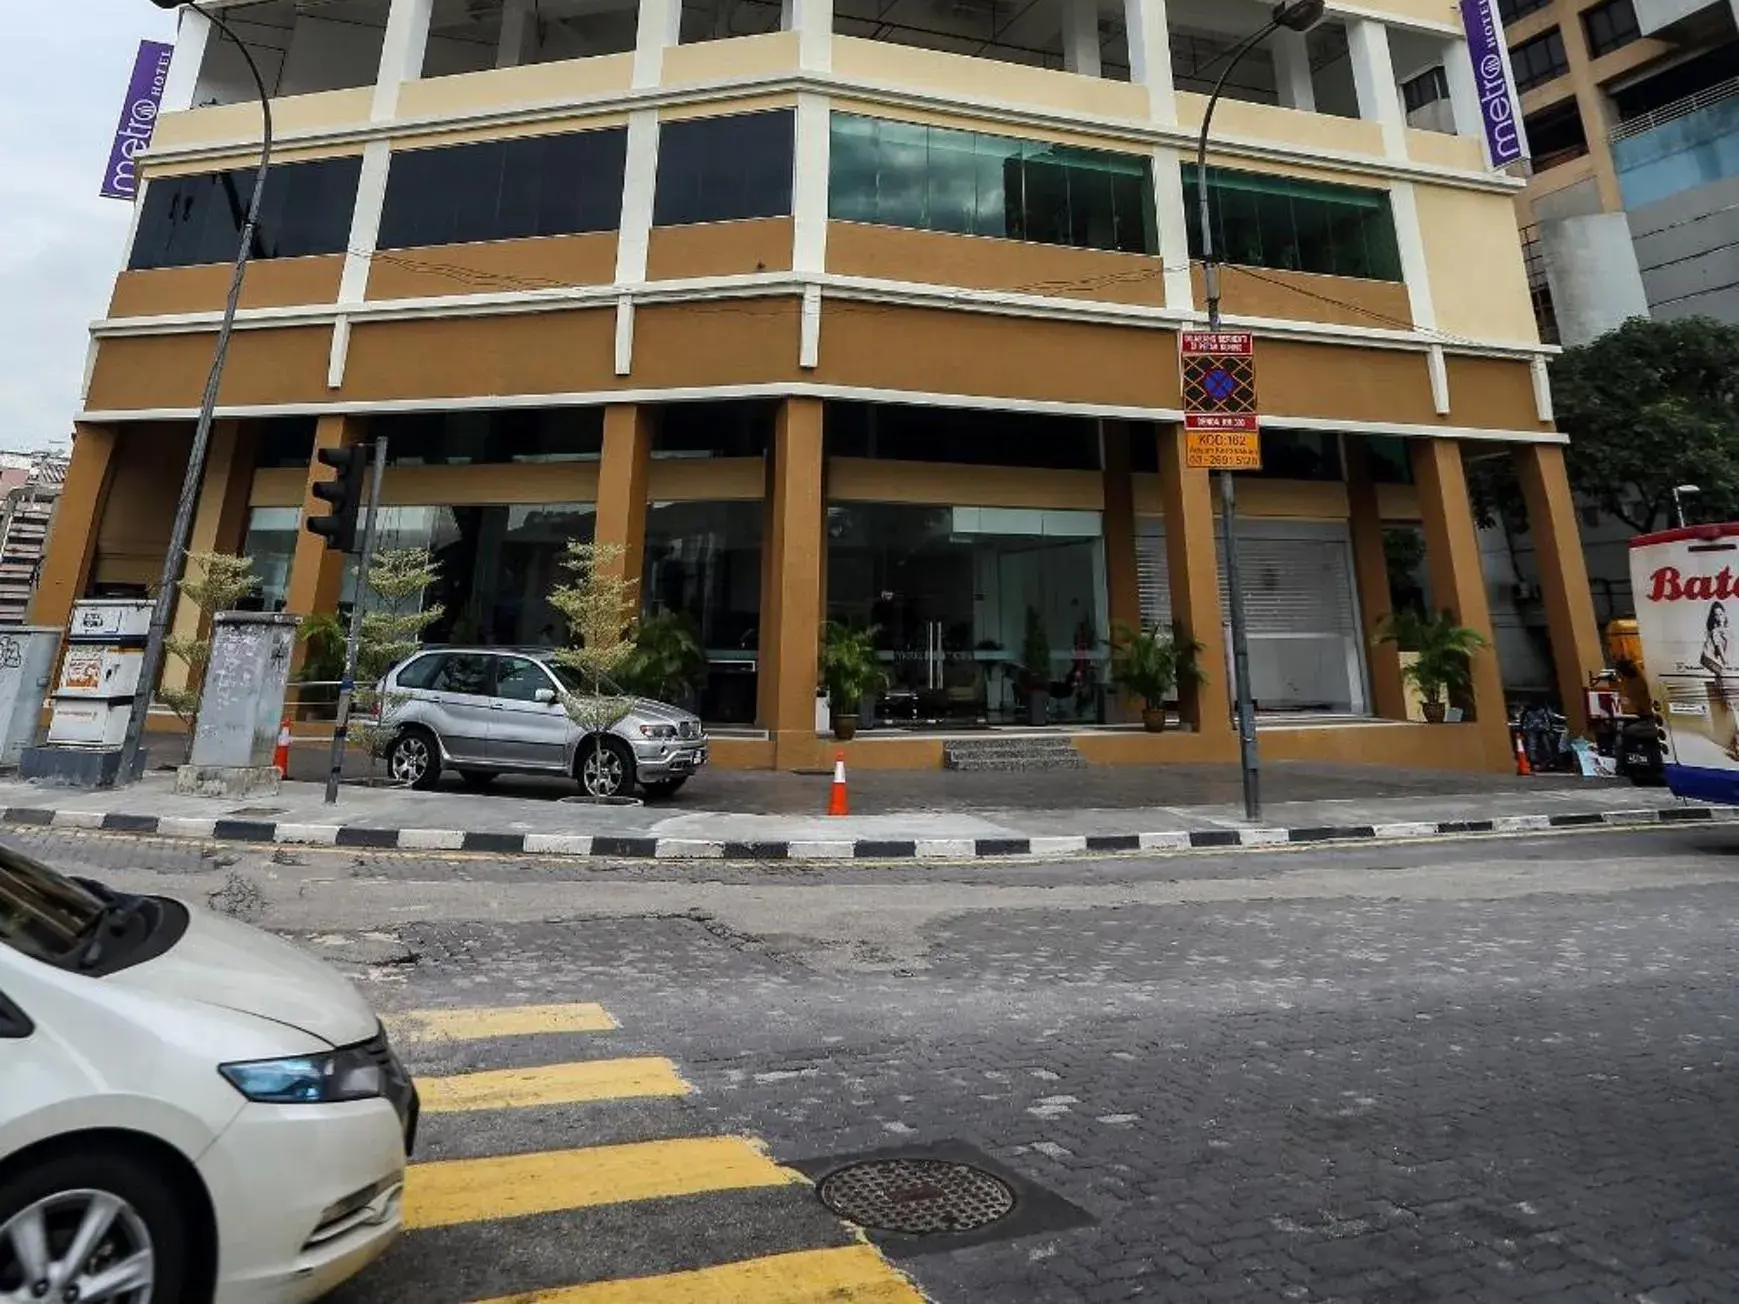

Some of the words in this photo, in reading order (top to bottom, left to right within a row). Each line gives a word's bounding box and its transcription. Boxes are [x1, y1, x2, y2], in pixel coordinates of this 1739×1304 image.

[113, 99, 157, 193] metro
[151, 50, 171, 96] HOTEL
[1481, 54, 1519, 158] metro
[1647, 565, 1739, 602] Bat
